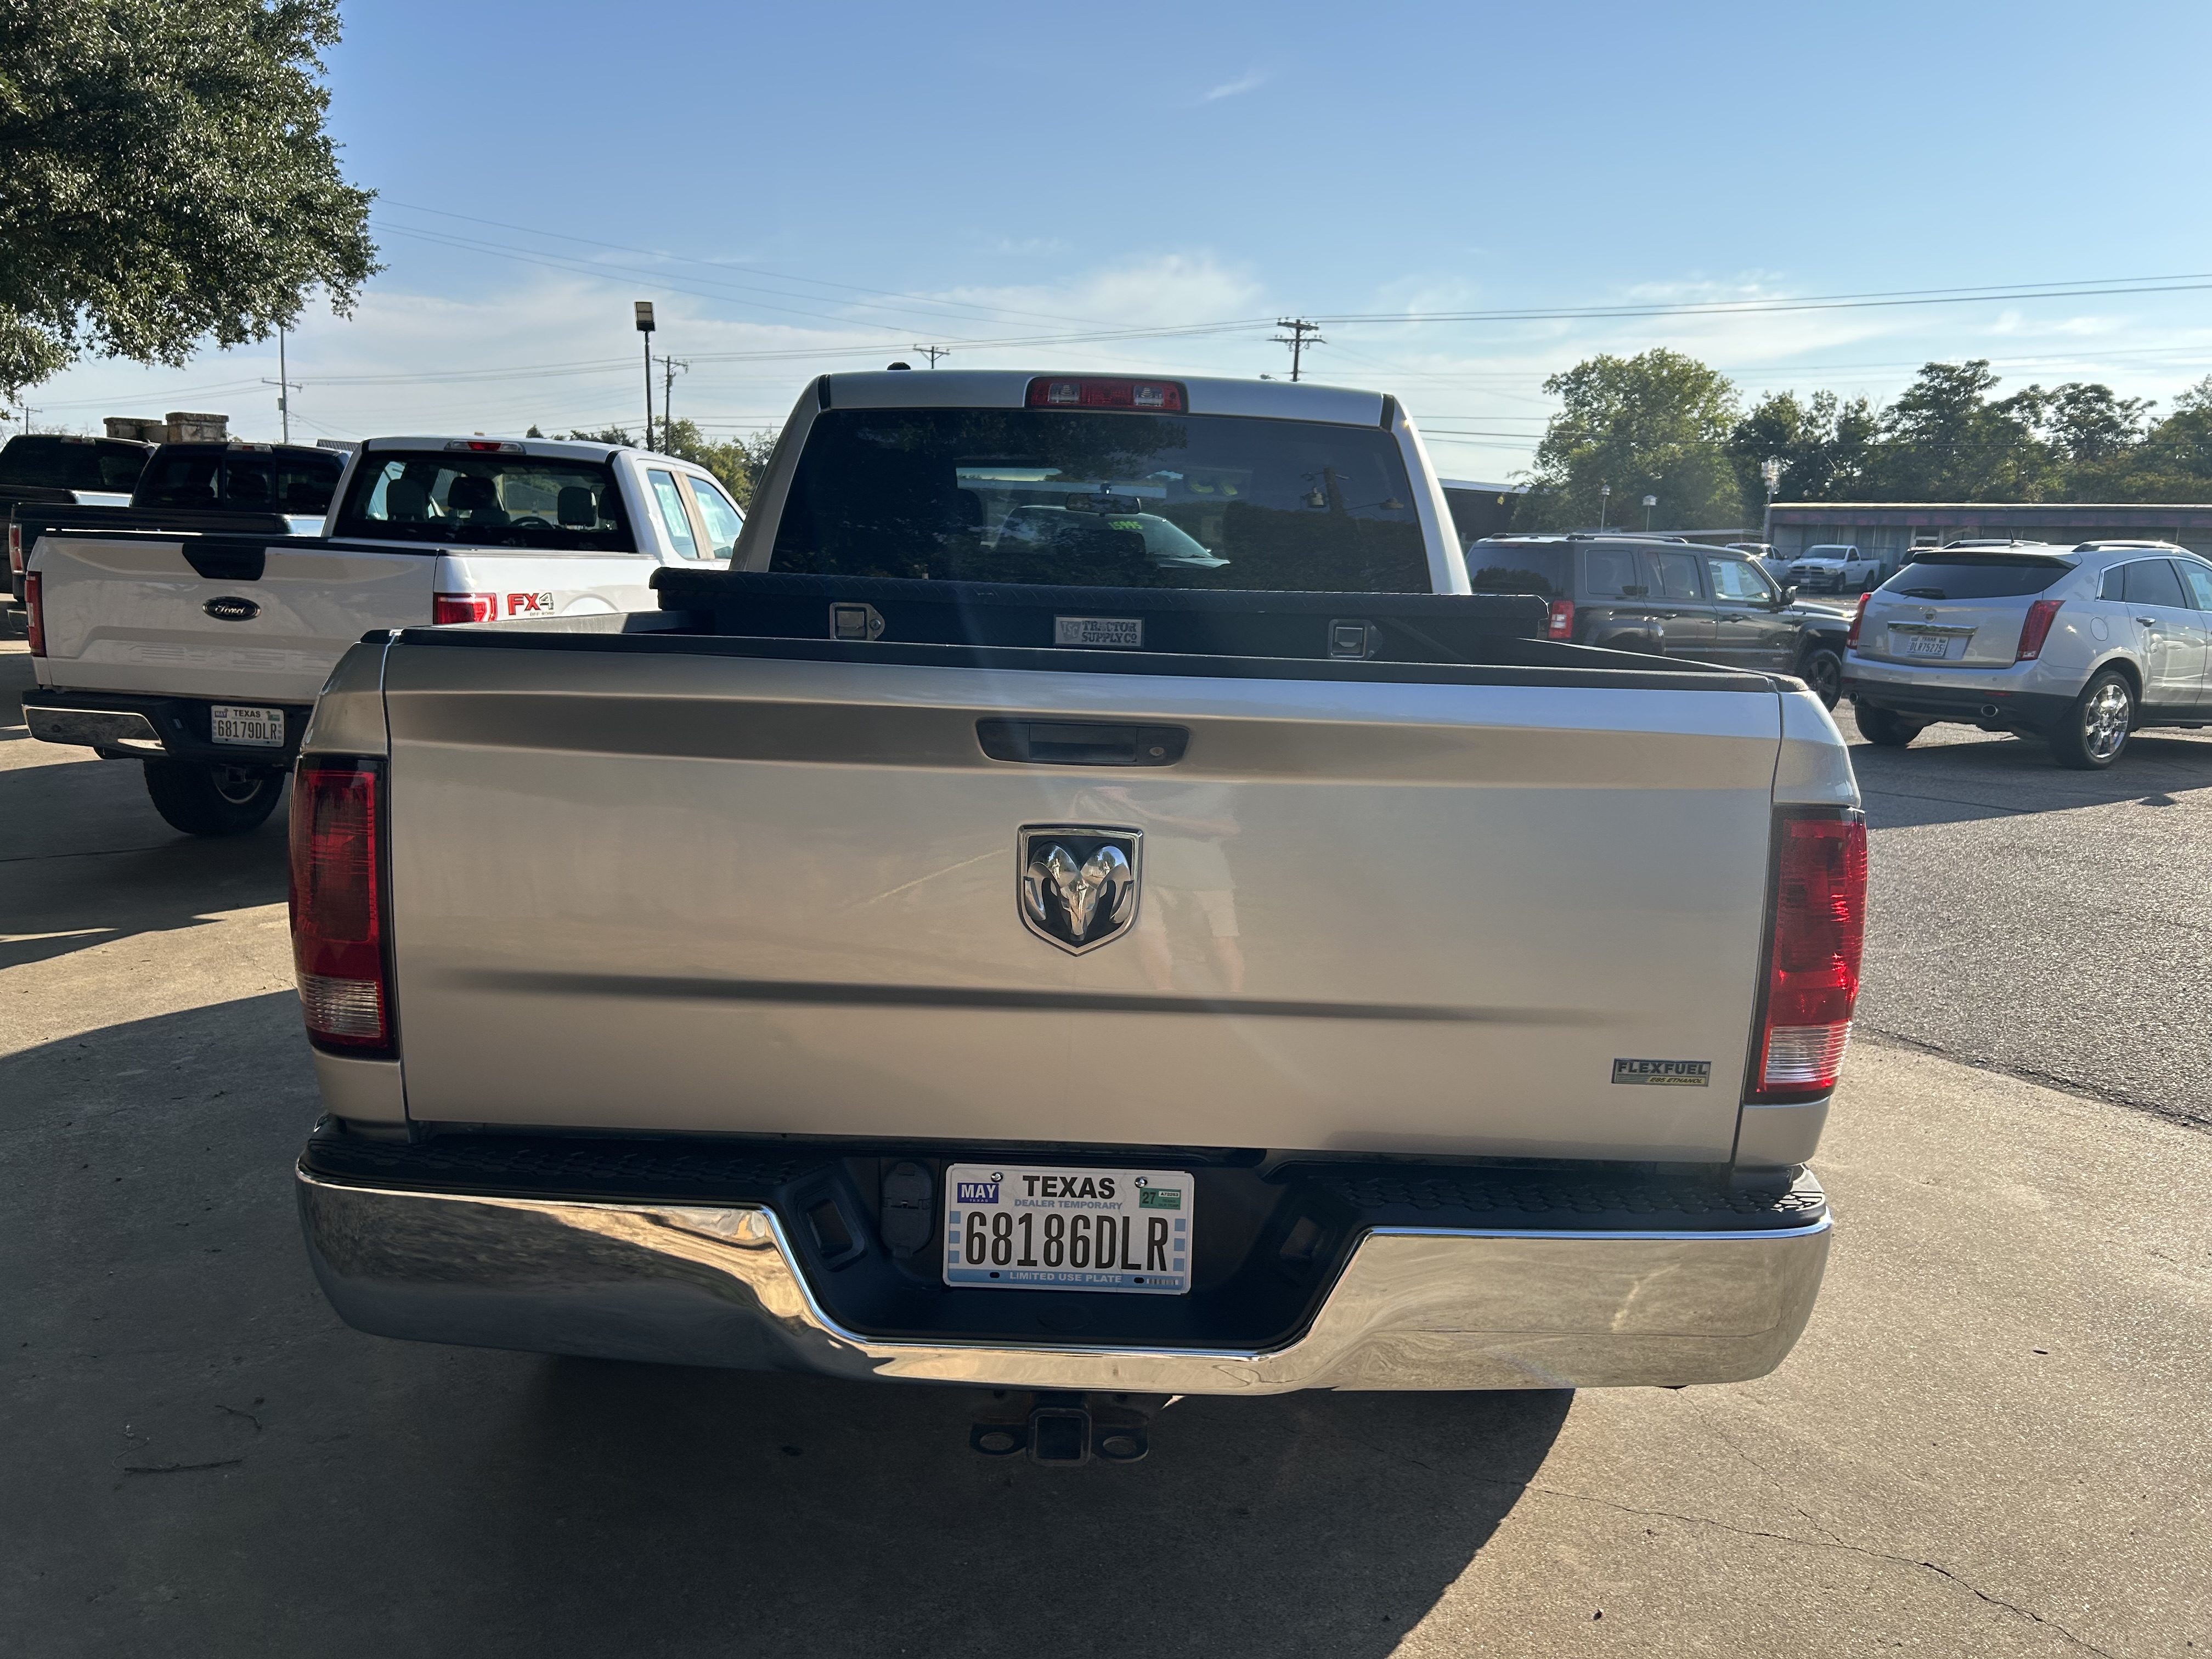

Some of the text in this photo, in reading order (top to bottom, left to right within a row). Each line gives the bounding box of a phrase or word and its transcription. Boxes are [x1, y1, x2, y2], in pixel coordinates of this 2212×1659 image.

[507, 592, 554, 616] FX4
[1062, 621, 1078, 637] TSC
[1081, 631, 1123, 643] SUPPLY
[233, 709, 261, 718] TEXAS
[218, 720, 277, 740] 68179DLR
[961, 1184, 996, 1198] MAY
[1023, 1175, 1115, 1199] TEXAS
[1014, 1199, 1123, 1210] DEALER TEMPORARY
[1142, 1192, 1156, 1204] 27
[966, 1211, 1169, 1271] 68186DLR
[1009, 1271, 1122, 1283] LIMITED USE PLATE
